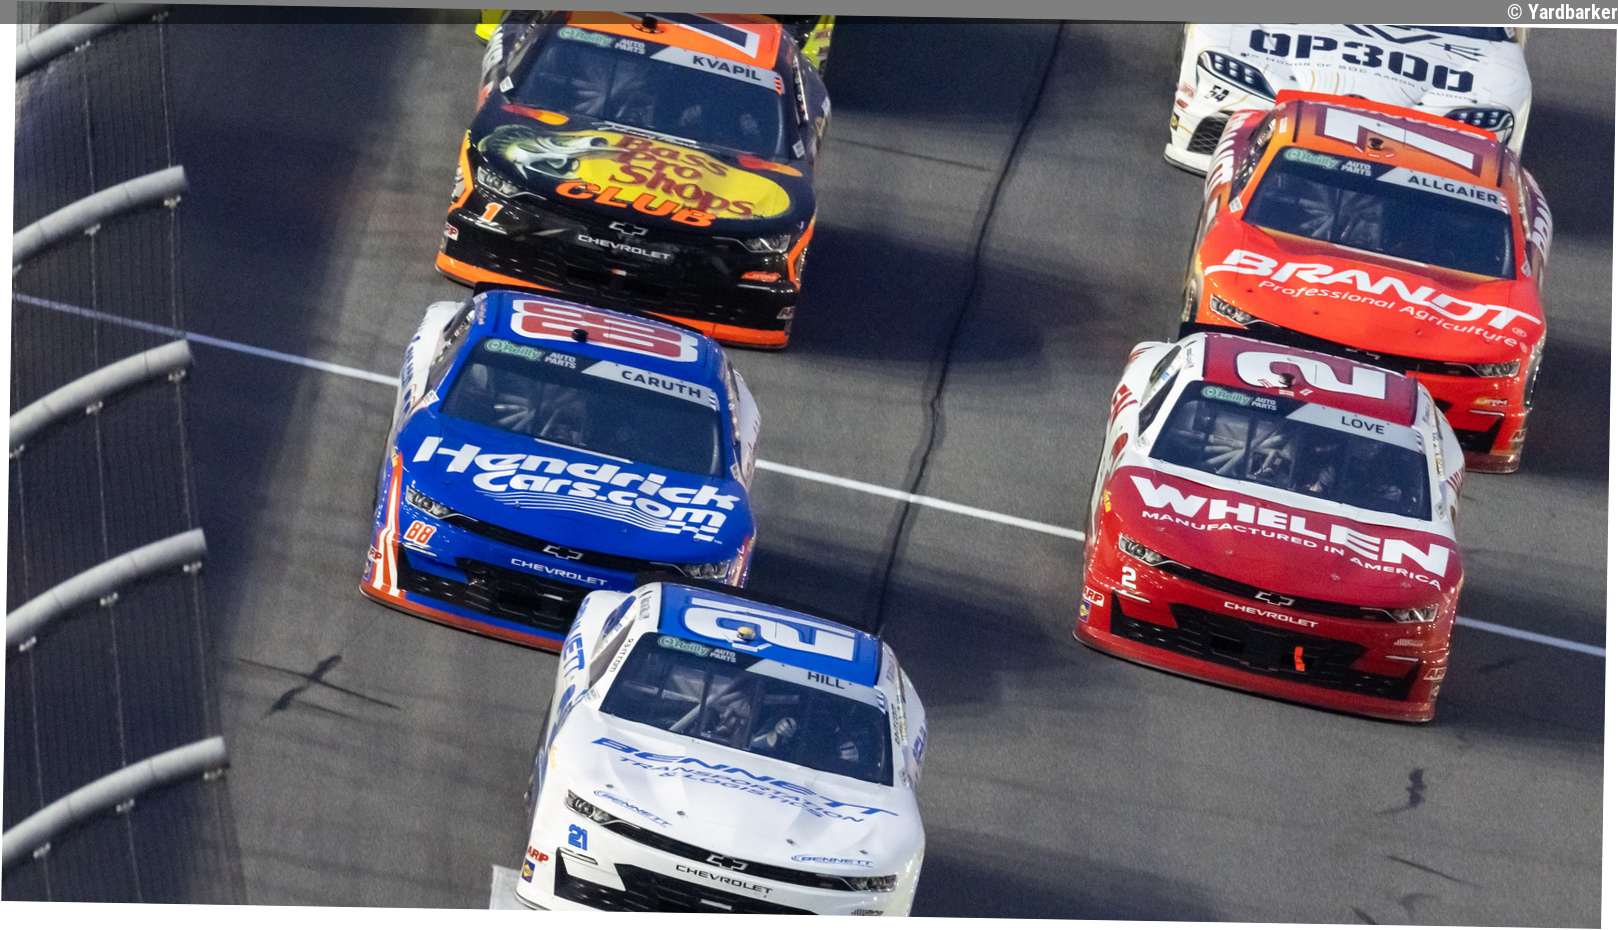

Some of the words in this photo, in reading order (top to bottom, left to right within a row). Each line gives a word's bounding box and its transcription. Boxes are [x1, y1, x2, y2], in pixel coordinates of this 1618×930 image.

[614, 43, 646, 55] PARTS
[622, 38, 645, 48] AUTO
[692, 55, 762, 81] KVAPIL
[1266, 56, 1311, 67] HONOR
[1373, 72, 1416, 88] AARON
[613, 150, 703, 180] Pro
[615, 135, 729, 177] Bass
[1346, 160, 1371, 170] AUTO
[1341, 164, 1372, 177] PARTS
[608, 165, 755, 216] Shops
[1407, 175, 1499, 205] ALLGAIER
[480, 201, 504, 223] 1
[555, 181, 717, 227] CLUB
[577, 234, 671, 260] CHEVROLET
[1205, 248, 1542, 330] BRANDT
[1258, 280, 1397, 309] Professional
[1398, 305, 1518, 348] Agriculture
[544, 356, 577, 370] PARTS
[550, 351, 577, 364] AUTO
[621, 370, 702, 399] CARUTH
[1250, 401, 1277, 411] PARTS
[1254, 396, 1277, 406] AUTO
[1340, 415, 1385, 436] LOVE
[412, 436, 740, 510] Hendrick
[472, 469, 728, 530] Cars.com
[404, 520, 437, 545] 88
[1129, 475, 1450, 577] WHELEN
[1140, 510, 1318, 549] MANUFACTURED
[1323, 545, 1345, 556] IN
[1349, 556, 1442, 592] AMERICA
[510, 558, 608, 587] CHEVROLET
[1121, 566, 1138, 590] 2
[1223, 601, 1319, 628] CHEVROLET
[708, 652, 738, 664] PARTS
[713, 648, 737, 658] AUTO
[806, 670, 846, 690] HILL
[591, 736, 899, 817] BENNETT
[619, 756, 865, 823] TRANSPORTATION
[682, 773, 825, 818] LOGISTICS
[600, 792, 673, 829] BENNETT
[567, 824, 589, 851] 21
[800, 855, 874, 868] BENNETT
[675, 863, 775, 895] CHEVROLET
